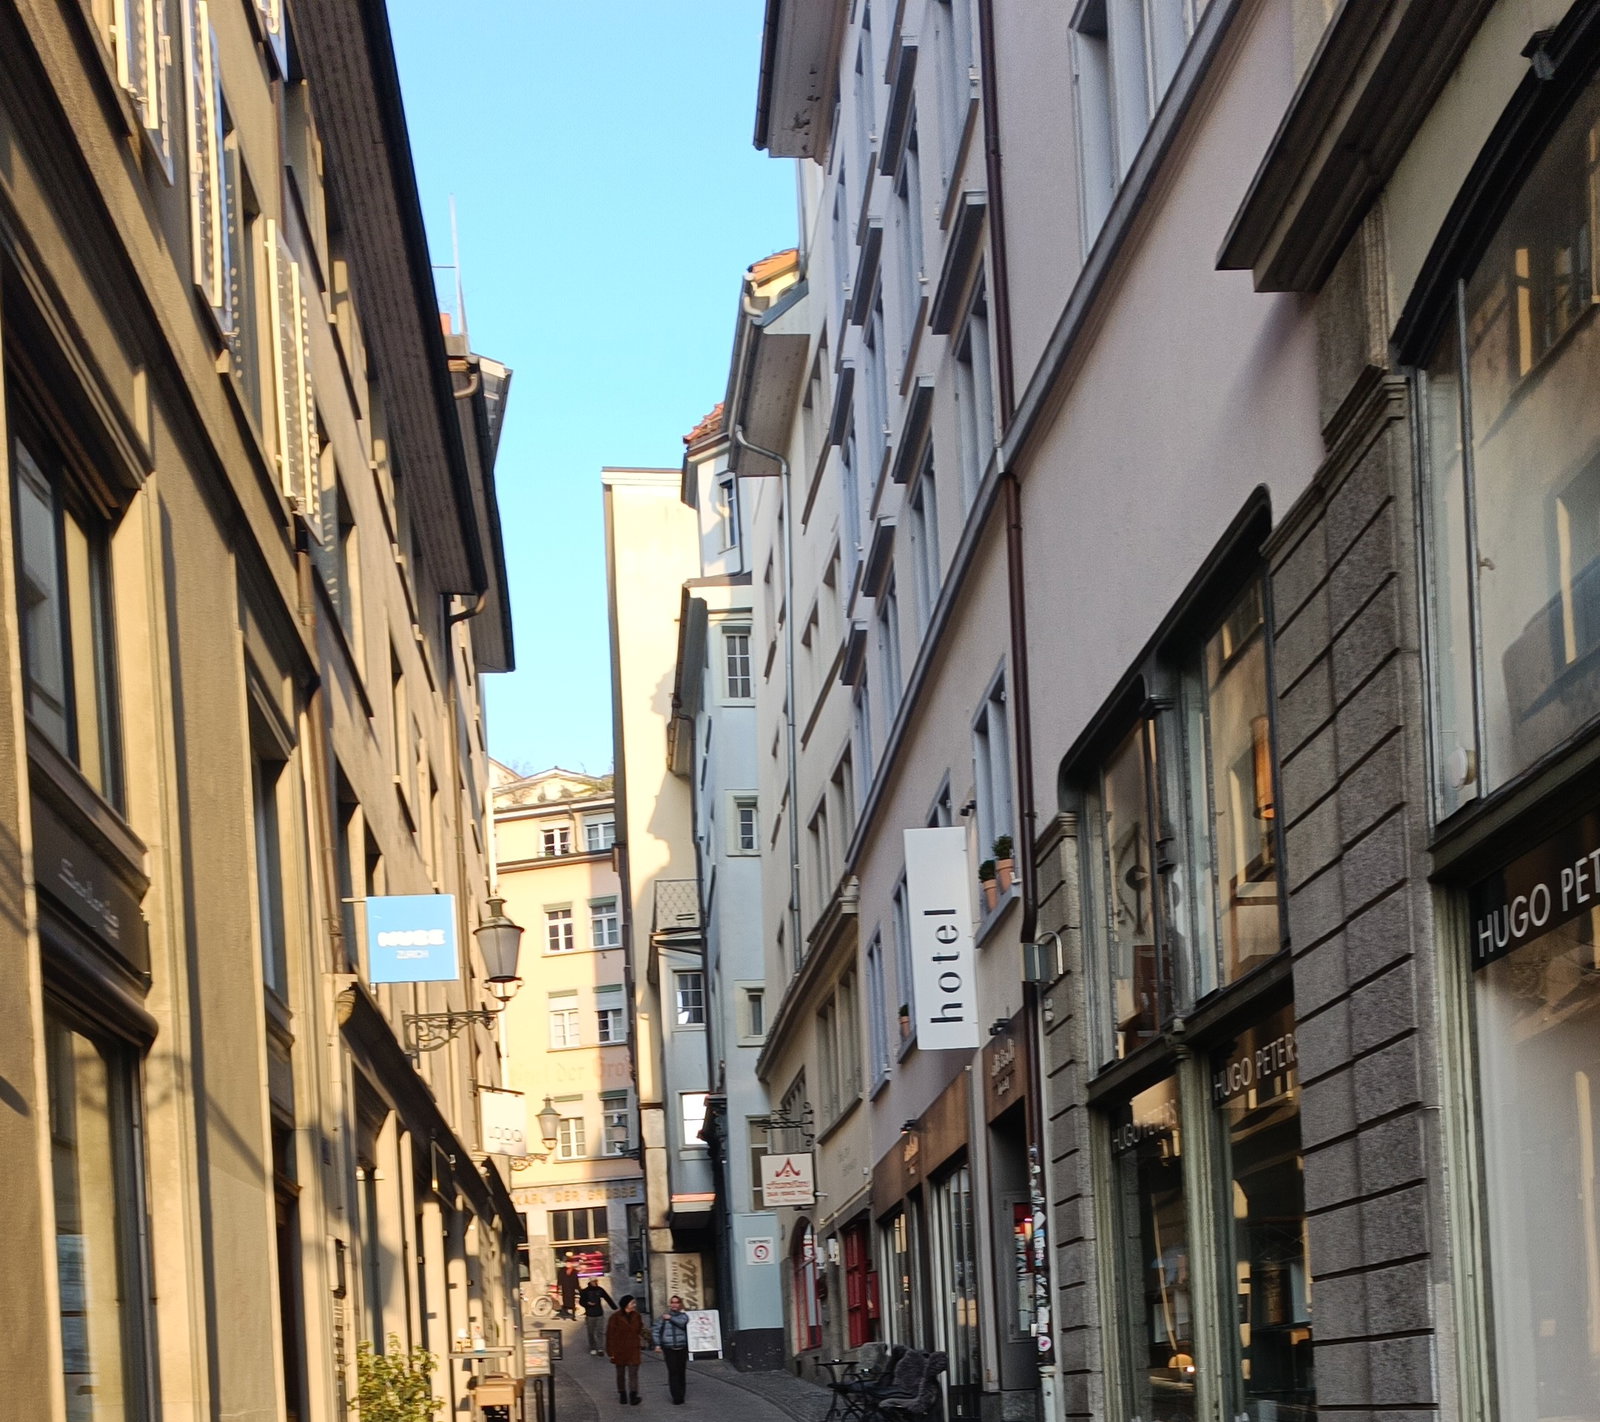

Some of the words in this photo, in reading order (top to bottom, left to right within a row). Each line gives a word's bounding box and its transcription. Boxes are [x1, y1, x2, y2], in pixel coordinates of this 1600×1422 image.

[1478, 883, 1551, 957] HUGO
[923, 909, 963, 1023] hotel
[1213, 1057, 1253, 1101] HUGO
[1255, 1033, 1299, 1080] PETER
[554, 1190, 579, 1203] DER
